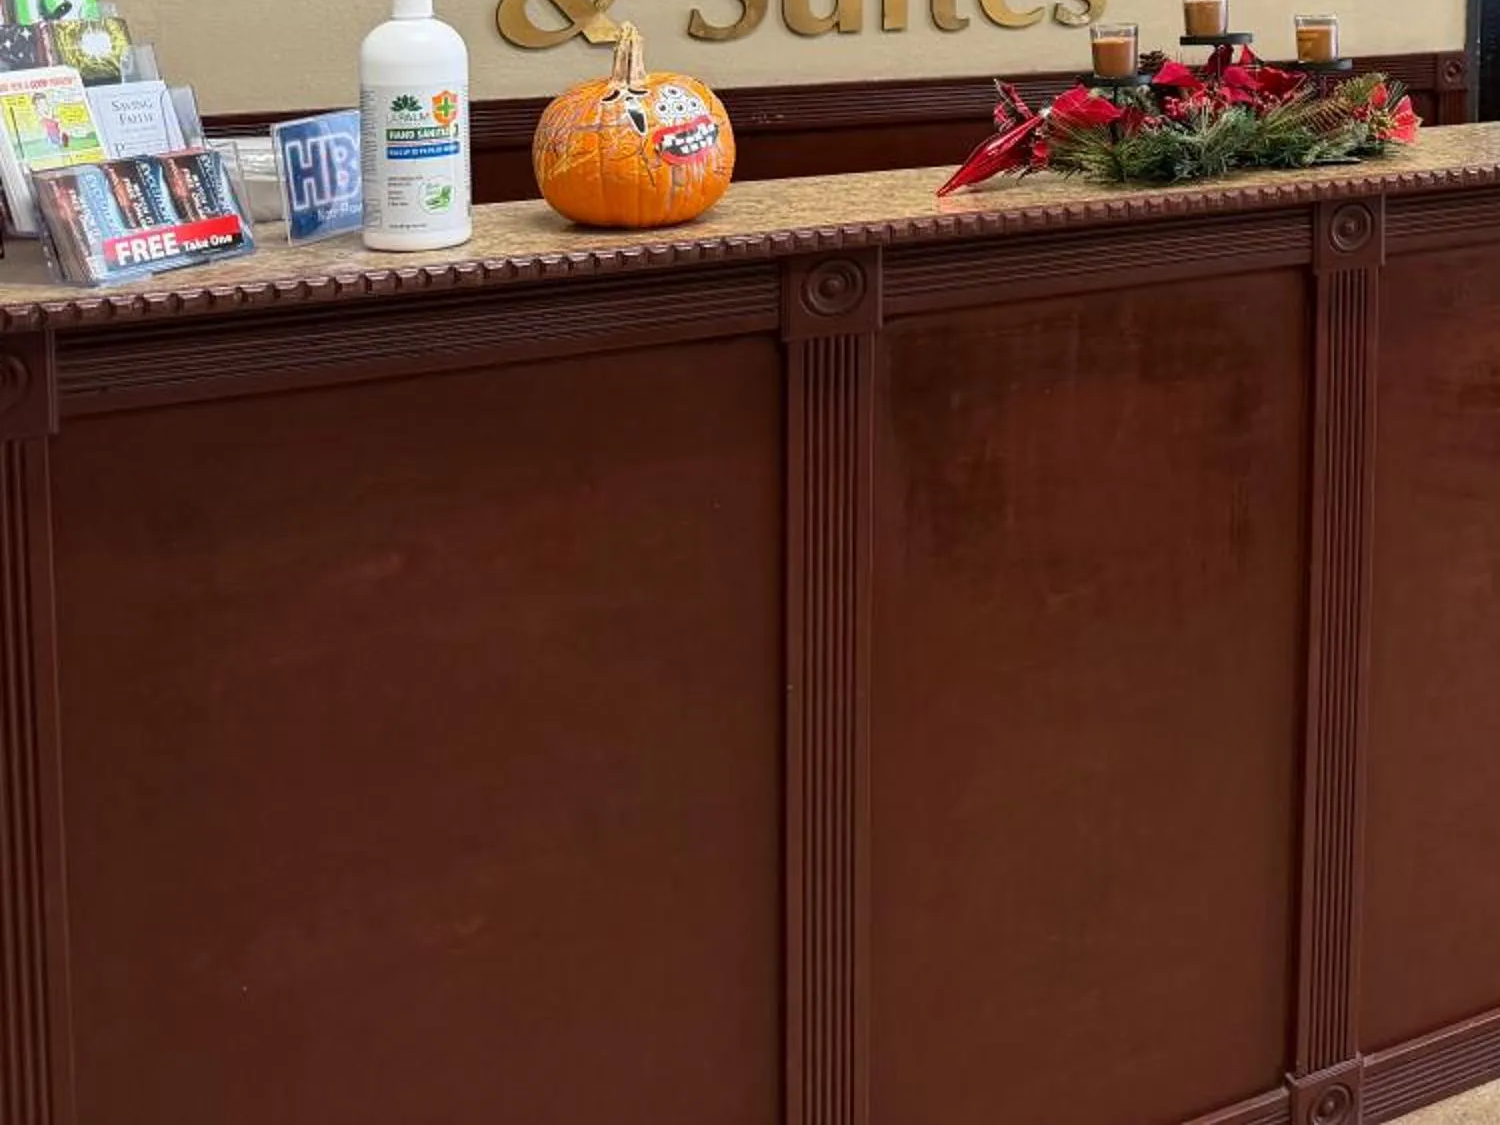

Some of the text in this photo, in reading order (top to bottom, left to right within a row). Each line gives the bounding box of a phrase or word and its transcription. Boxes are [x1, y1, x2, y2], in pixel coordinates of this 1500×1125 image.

[115, 232, 232, 266] FREE Take One
